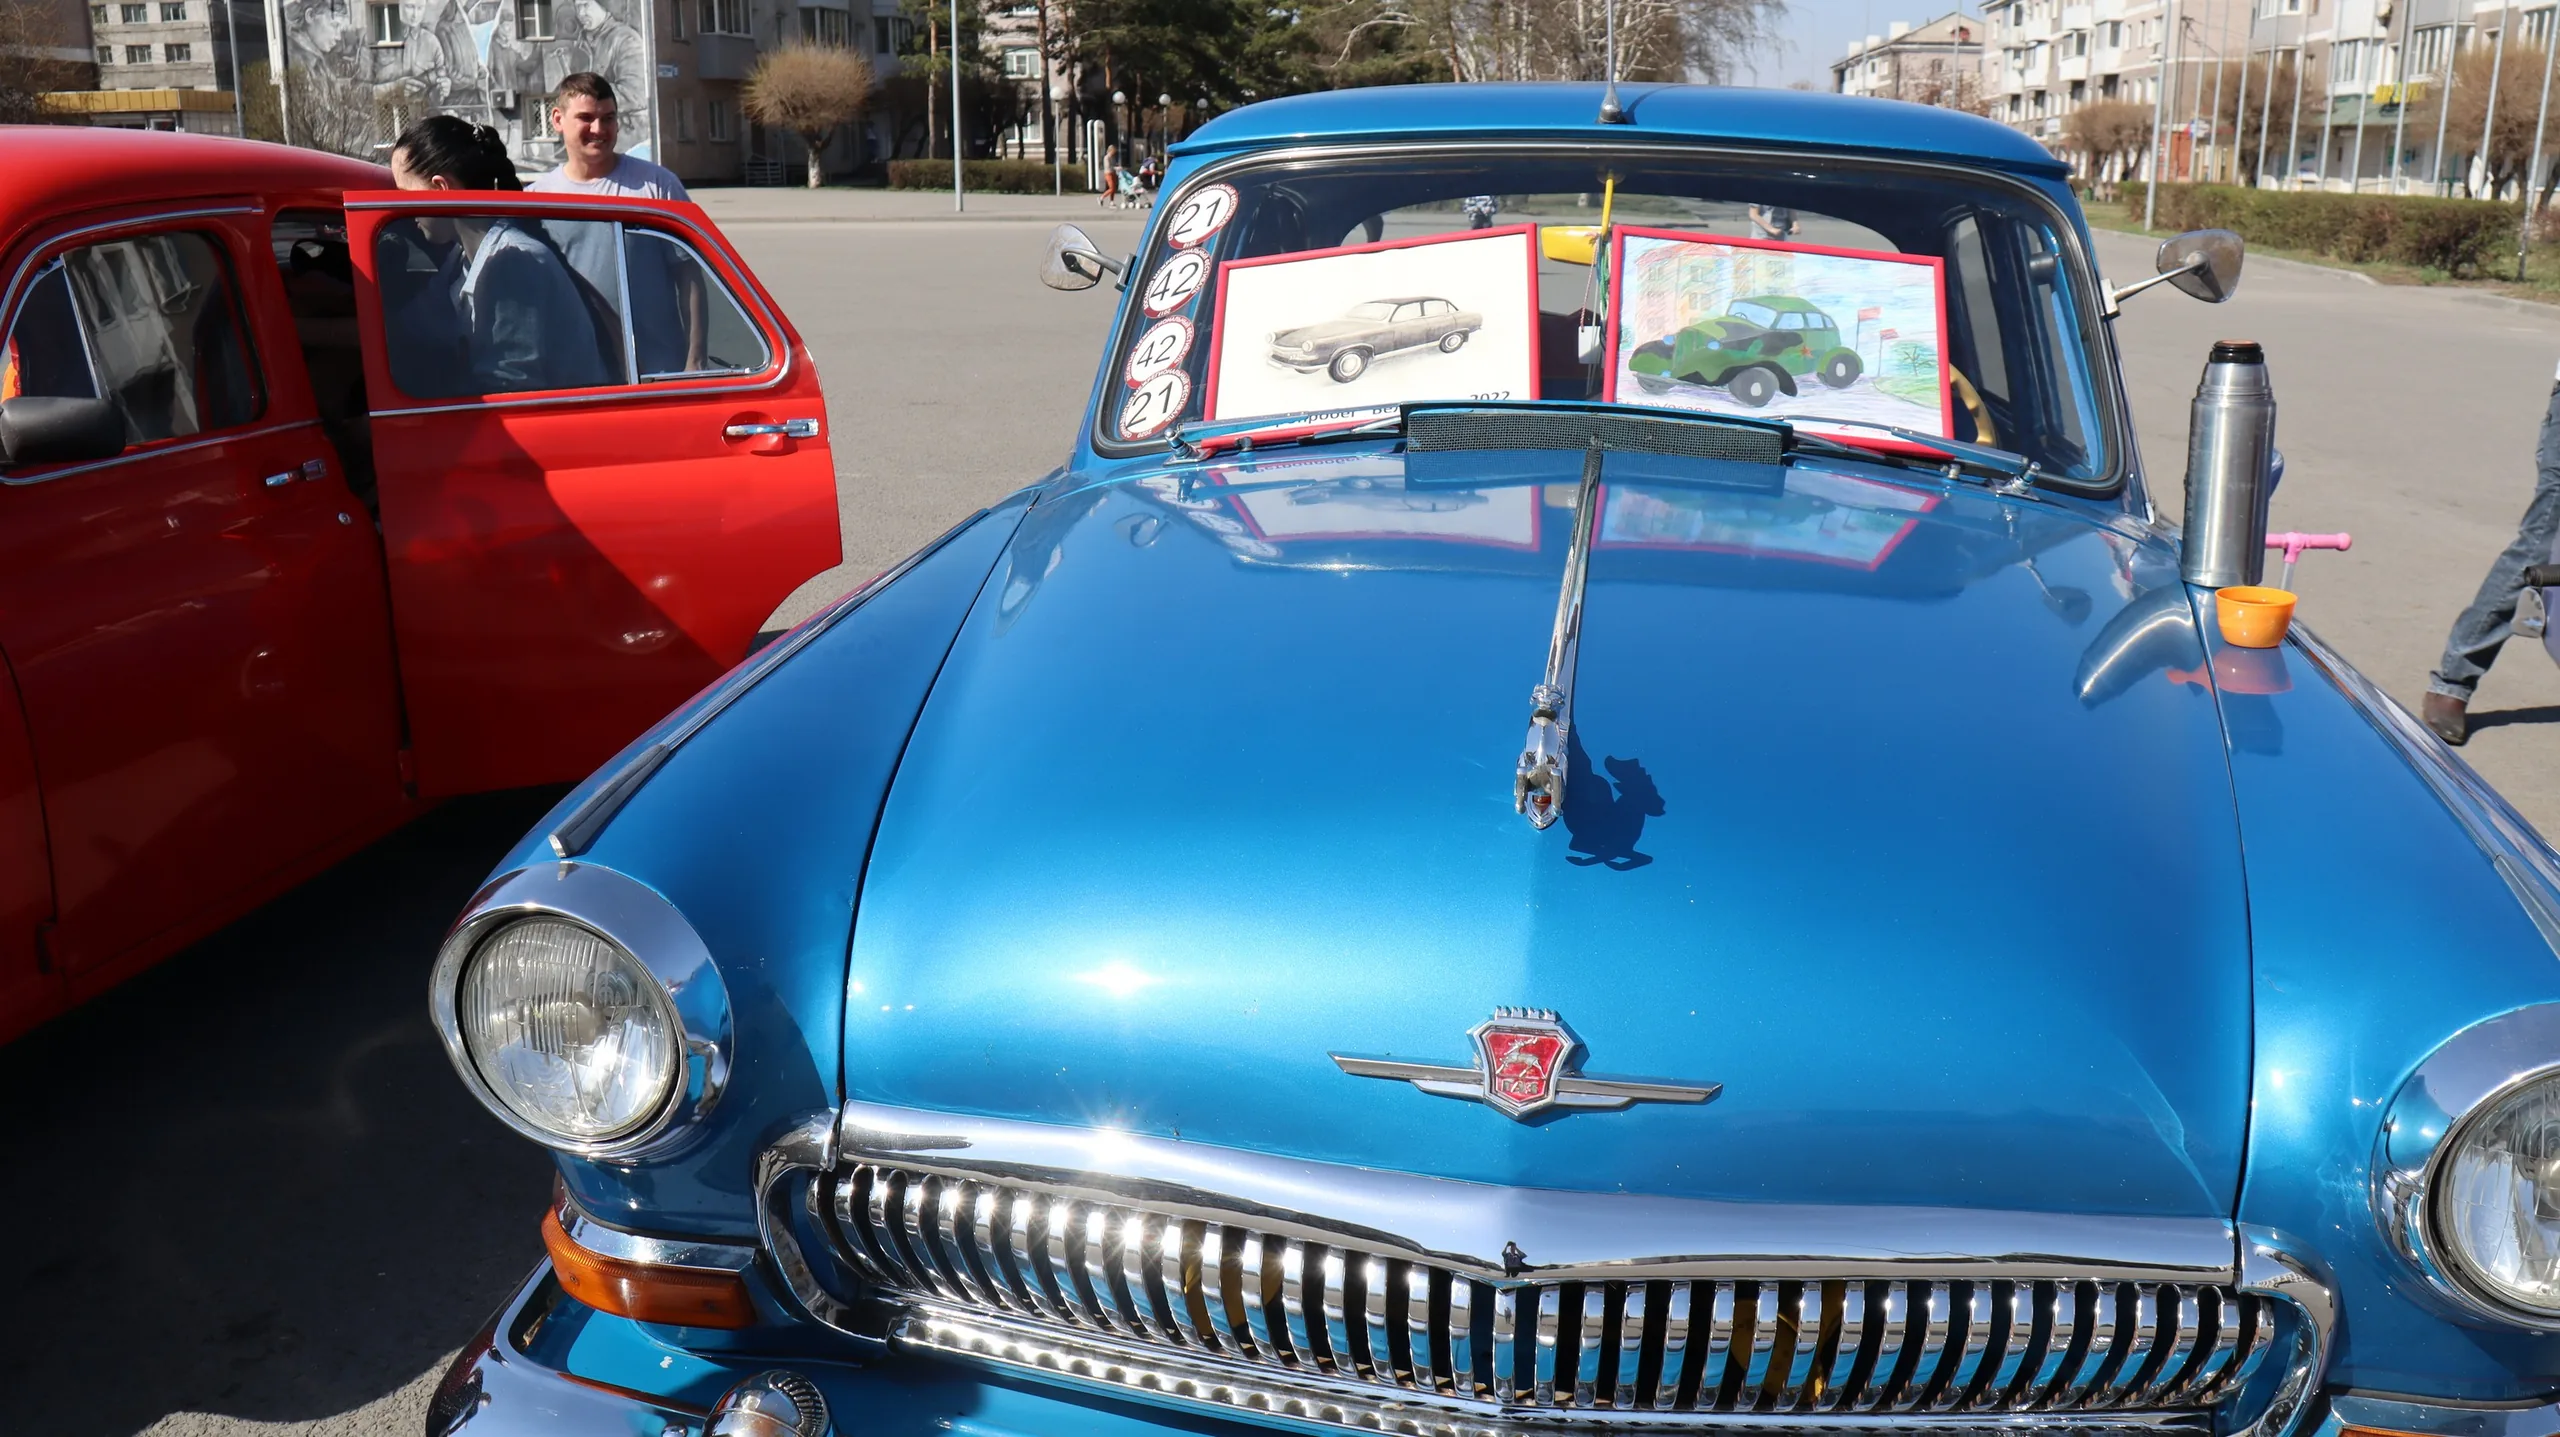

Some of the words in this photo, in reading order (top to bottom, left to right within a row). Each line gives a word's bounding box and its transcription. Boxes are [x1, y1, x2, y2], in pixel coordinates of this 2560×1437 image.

[1174, 197, 1221, 236] 21
[1150, 262, 1199, 300] 42
[1137, 334, 1176, 367] 42
[1126, 381, 1173, 429] 21
[1501, 1079, 1538, 1095] ГАЗ
